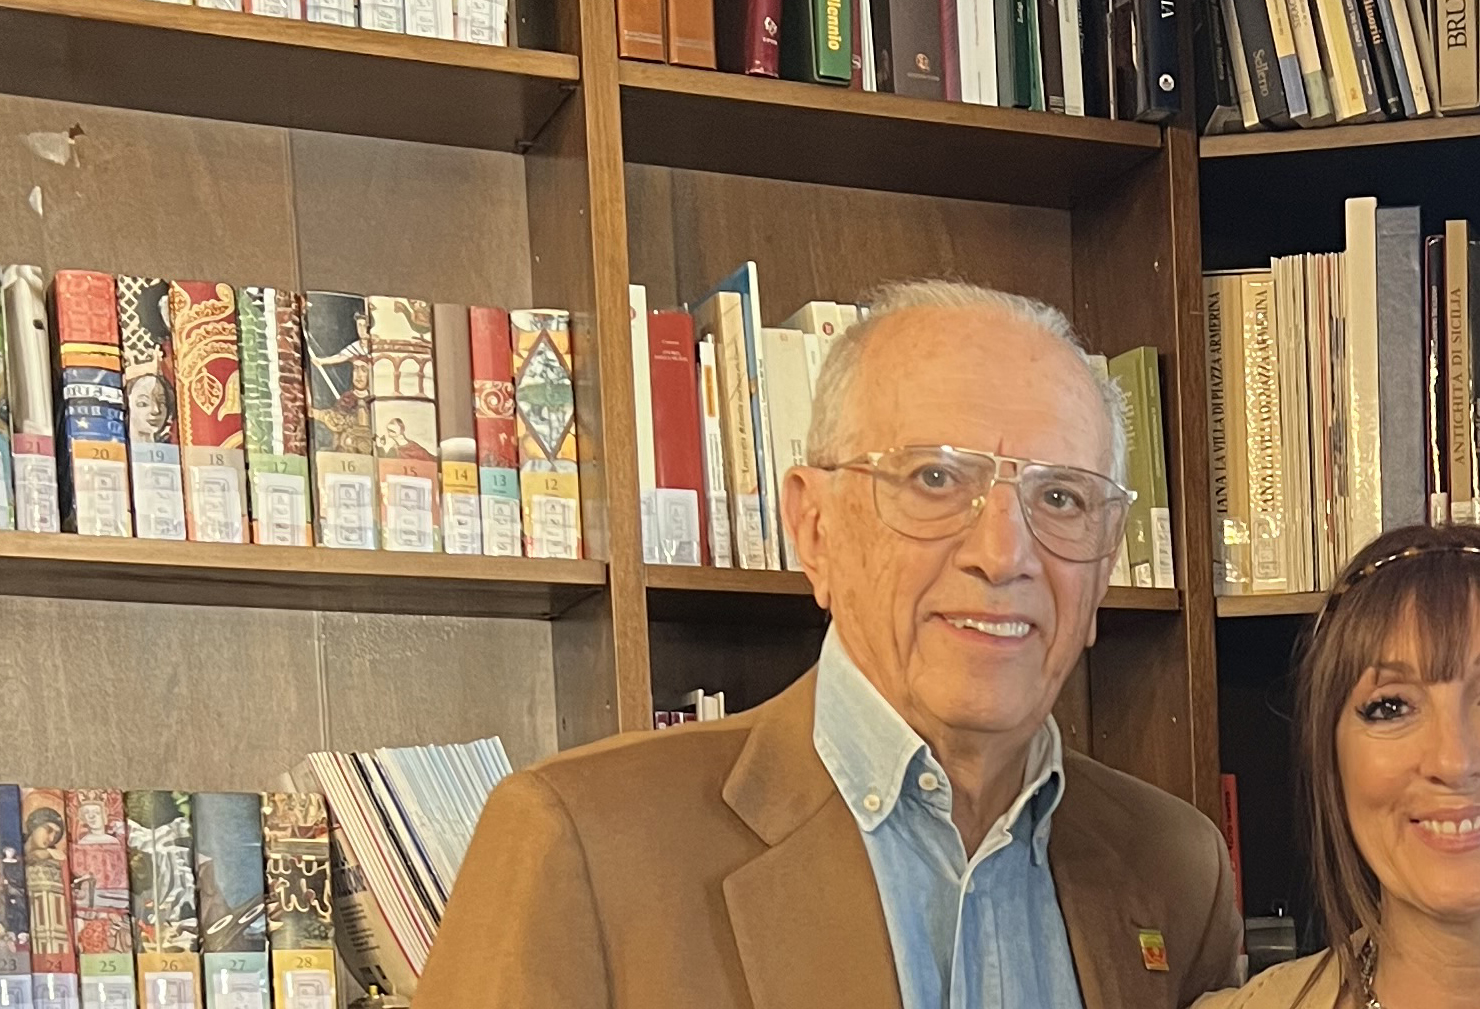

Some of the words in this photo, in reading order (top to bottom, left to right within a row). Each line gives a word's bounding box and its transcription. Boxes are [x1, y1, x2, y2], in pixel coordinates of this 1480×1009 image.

[1252, 48, 1270, 97] Sellerio
[1255, 290, 1269, 351] ARMERINA
[1450, 288, 1462, 343] SICILIA
[1208, 291, 1222, 354] ARMERINA
[1452, 350, 1463, 366] DI
[1210, 357, 1223, 400] PIAZZA
[1257, 356, 1271, 398] PIAZZA
[1212, 402, 1225, 416] DI
[1213, 418, 1226, 453] VILLA
[25, 441, 41, 453] 21
[92, 447, 110, 460] 20
[149, 449, 165, 462] 19
[208, 453, 224, 466] 18
[273, 460, 288, 473] 17
[340, 460, 356, 473] 16
[1214, 456, 1226, 471] LA
[402, 465, 418, 476] 15
[454, 469, 469, 481] 14
[492, 475, 507, 487] 13
[545, 478, 559, 491] 12
[0, 960, 17, 972] 23
[47, 960, 63, 972] 24
[99, 960, 117, 972] 25
[161, 959, 179, 972] 26
[229, 959, 246, 971] 27
[296, 957, 313, 969] 28
